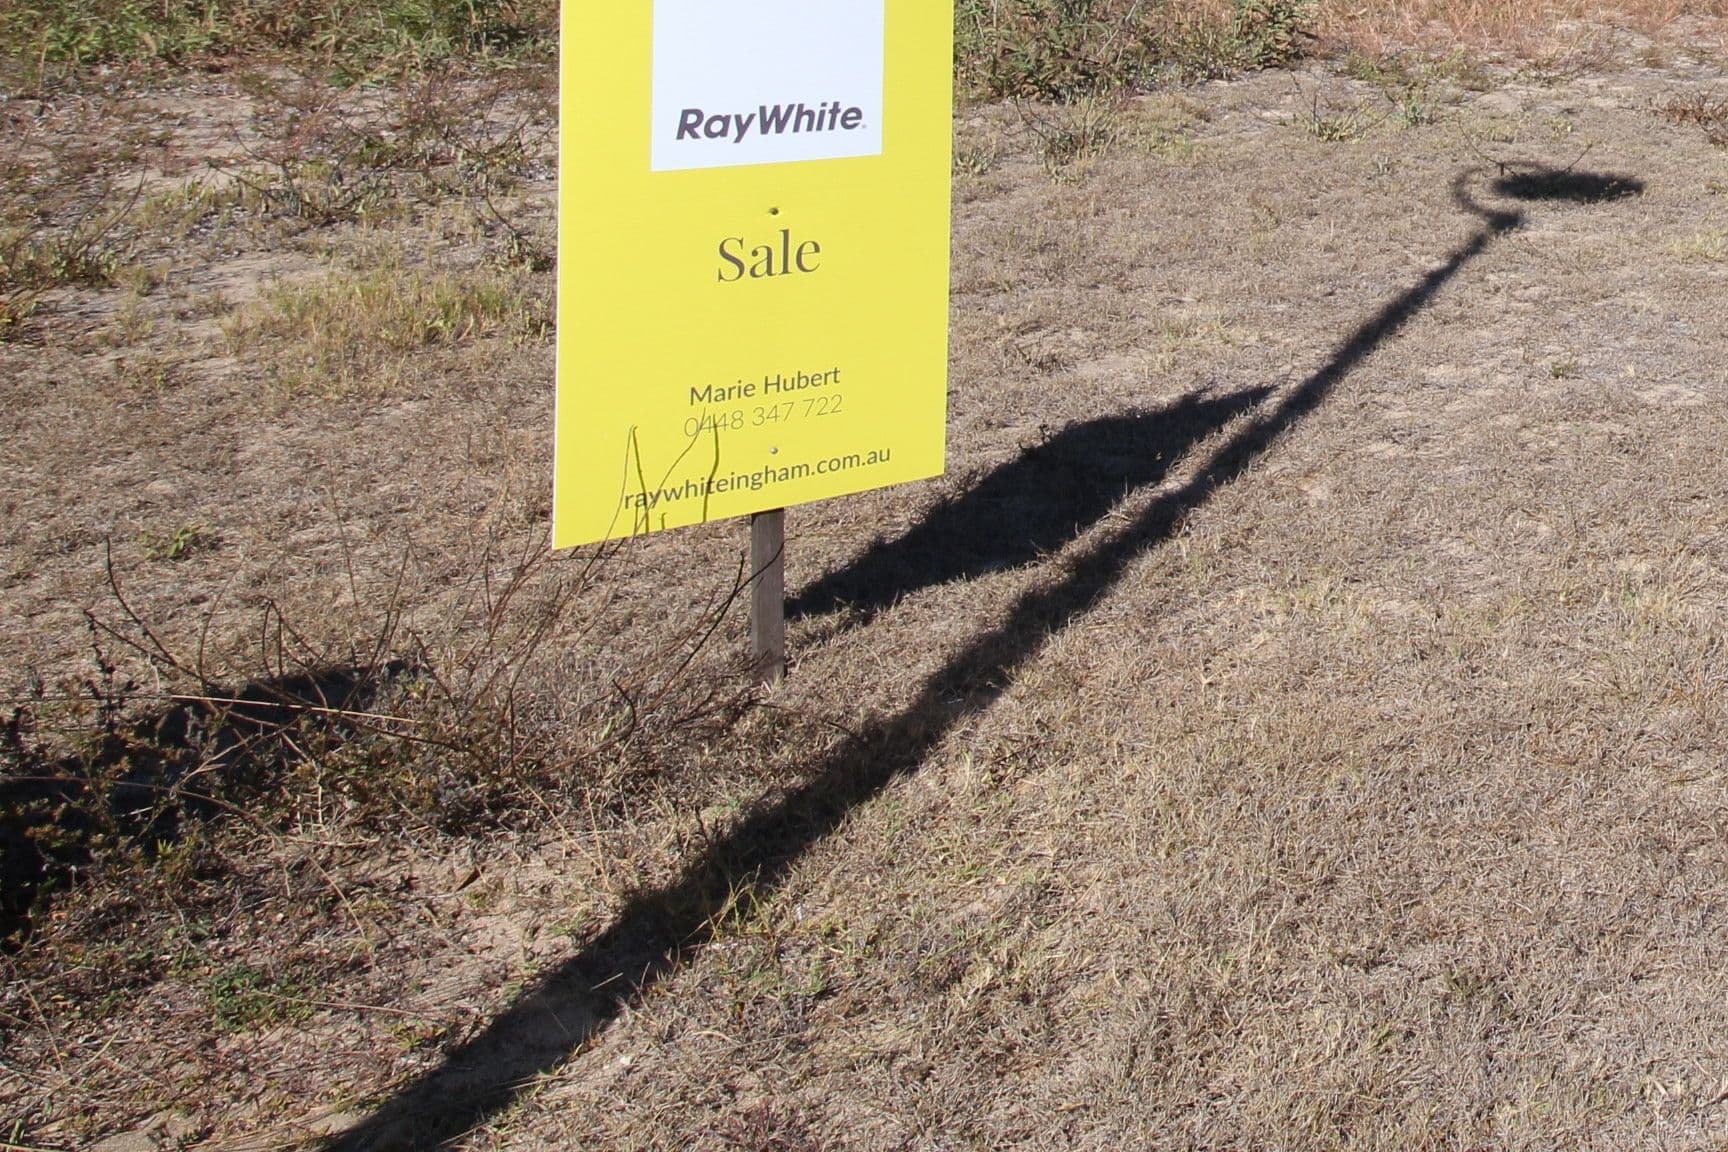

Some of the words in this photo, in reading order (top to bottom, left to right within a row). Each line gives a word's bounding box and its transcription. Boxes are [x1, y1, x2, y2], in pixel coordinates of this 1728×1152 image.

[718, 229, 821, 282] Sale
[690, 379, 756, 406] Marie
[764, 367, 841, 395] Hubert
[684, 409, 744, 438] 0448
[752, 401, 794, 427] 347
[803, 394, 843, 418] 722
[624, 448, 891, 510] raywhiteingham.com.au
